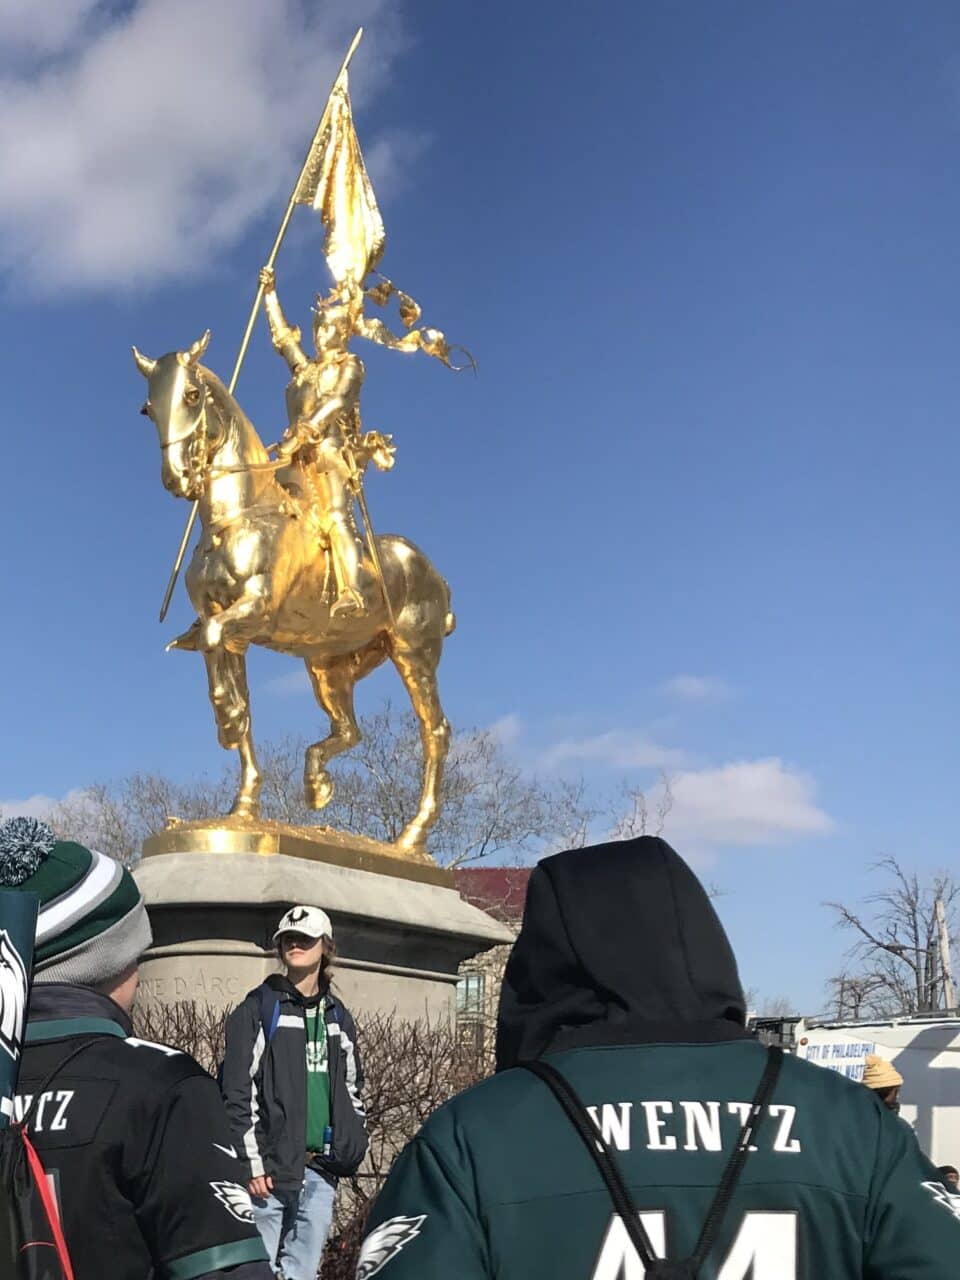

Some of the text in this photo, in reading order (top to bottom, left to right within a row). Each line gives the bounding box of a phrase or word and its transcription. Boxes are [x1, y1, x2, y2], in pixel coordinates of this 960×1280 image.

[806, 1045, 821, 1060] CITY
[822, 1044, 832, 1059] OF
[586, 1100, 802, 1153] WENTZ
